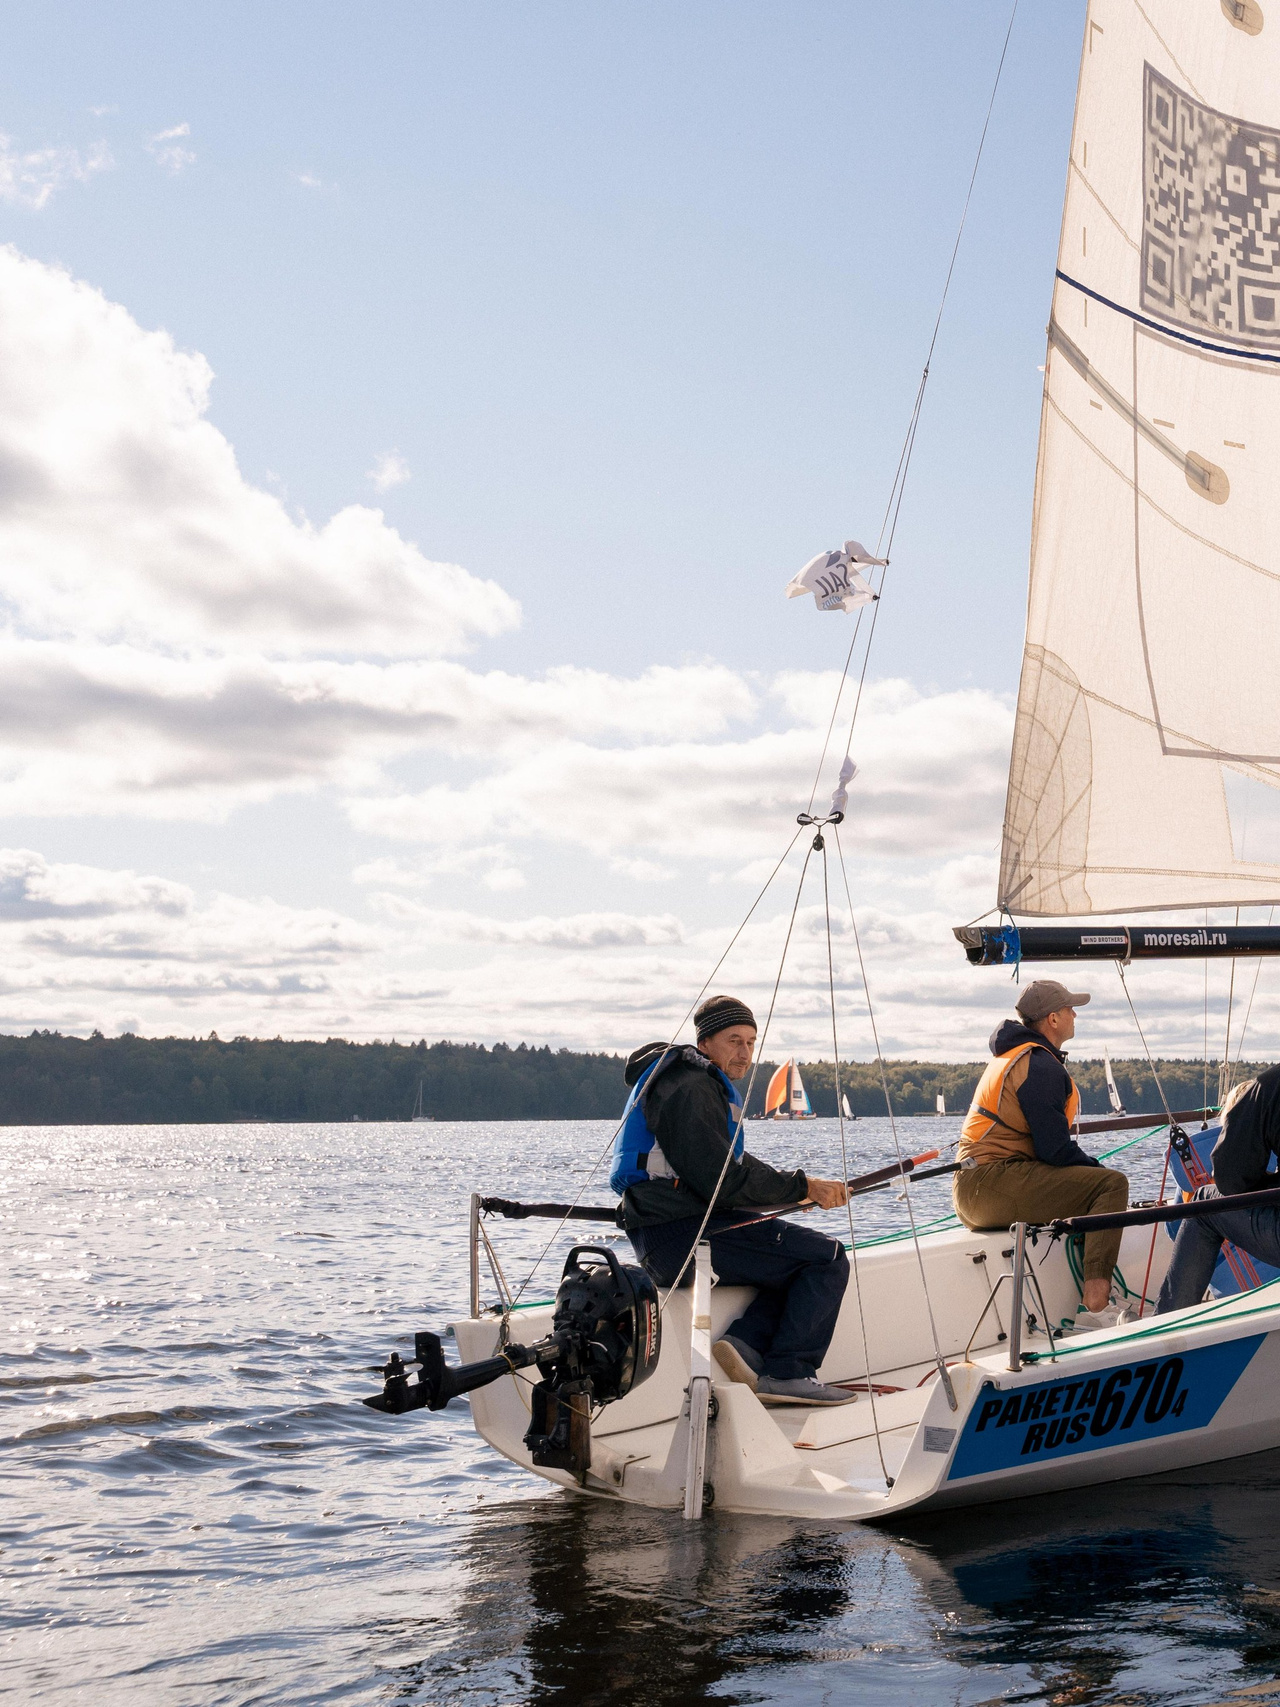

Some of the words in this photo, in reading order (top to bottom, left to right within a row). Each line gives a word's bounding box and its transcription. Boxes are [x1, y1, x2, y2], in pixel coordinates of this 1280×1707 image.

[1144, 929, 1227, 946] moresail.ru
[1089, 1357, 1185, 1437] 670
[1171, 1389, 1189, 1418] 4
[1020, 1411, 1091, 1456] RUS
